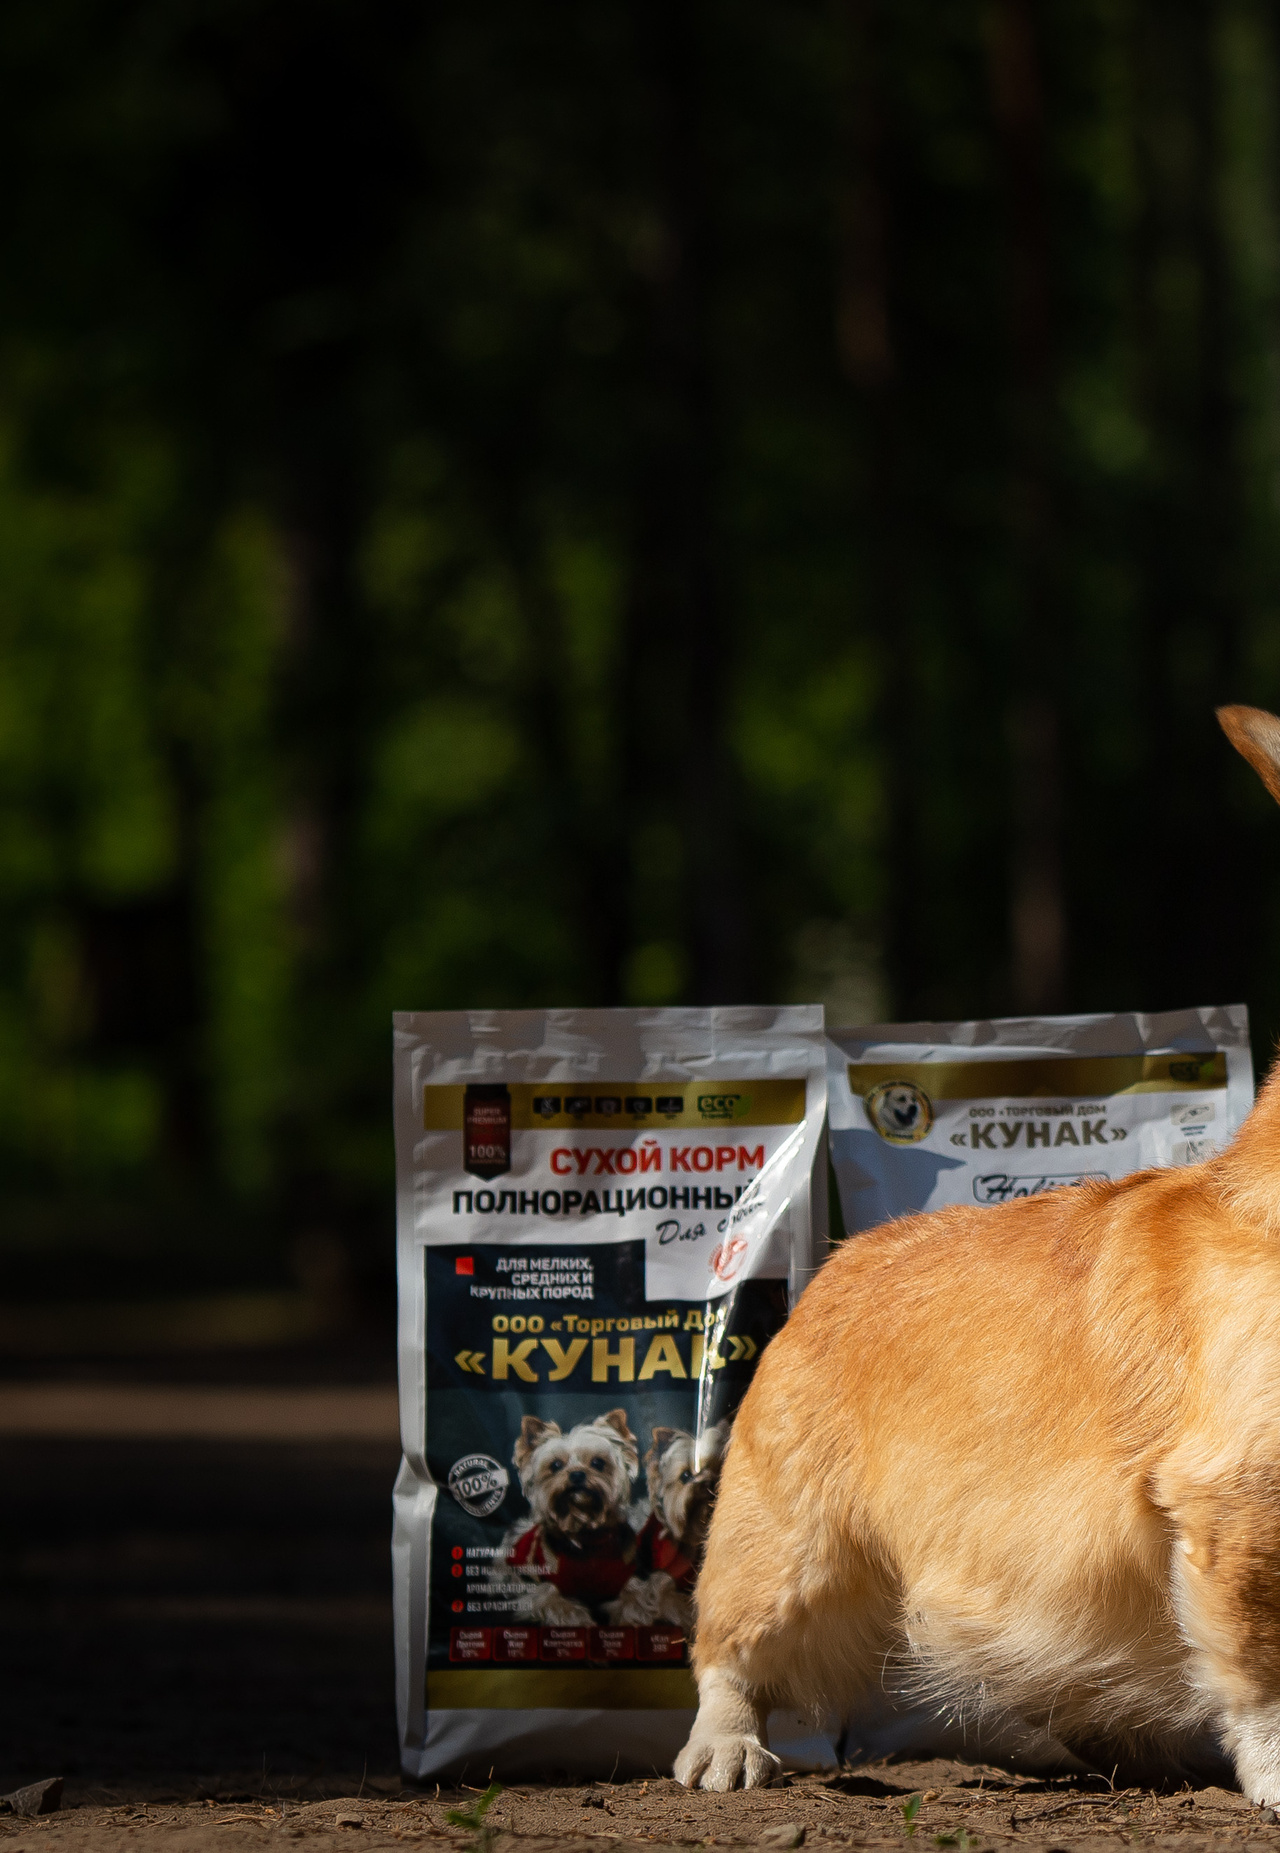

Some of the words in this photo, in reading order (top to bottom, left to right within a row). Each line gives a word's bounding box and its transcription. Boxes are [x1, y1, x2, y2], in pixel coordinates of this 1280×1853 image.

[969, 1107, 995, 1118] ООО
[1077, 1104, 1106, 1117] ДОМ
[950, 1119, 1127, 1149] «КУНАК»
[470, 1145, 506, 1159] 100%
[550, 1140, 662, 1176] СУХОЙ
[670, 1145, 765, 1172] КОРМ
[496, 1257, 527, 1273] ДЛЯ
[511, 1272, 580, 1287] СРЕДНИХ
[583, 1272, 594, 1285] И
[470, 1285, 541, 1300] КРУПНЫХ
[543, 1285, 595, 1300] ПОРОД
[492, 1315, 544, 1333] ООО
[550, 1309, 679, 1337] «Торговый
[455, 1472, 498, 1497] 100%
